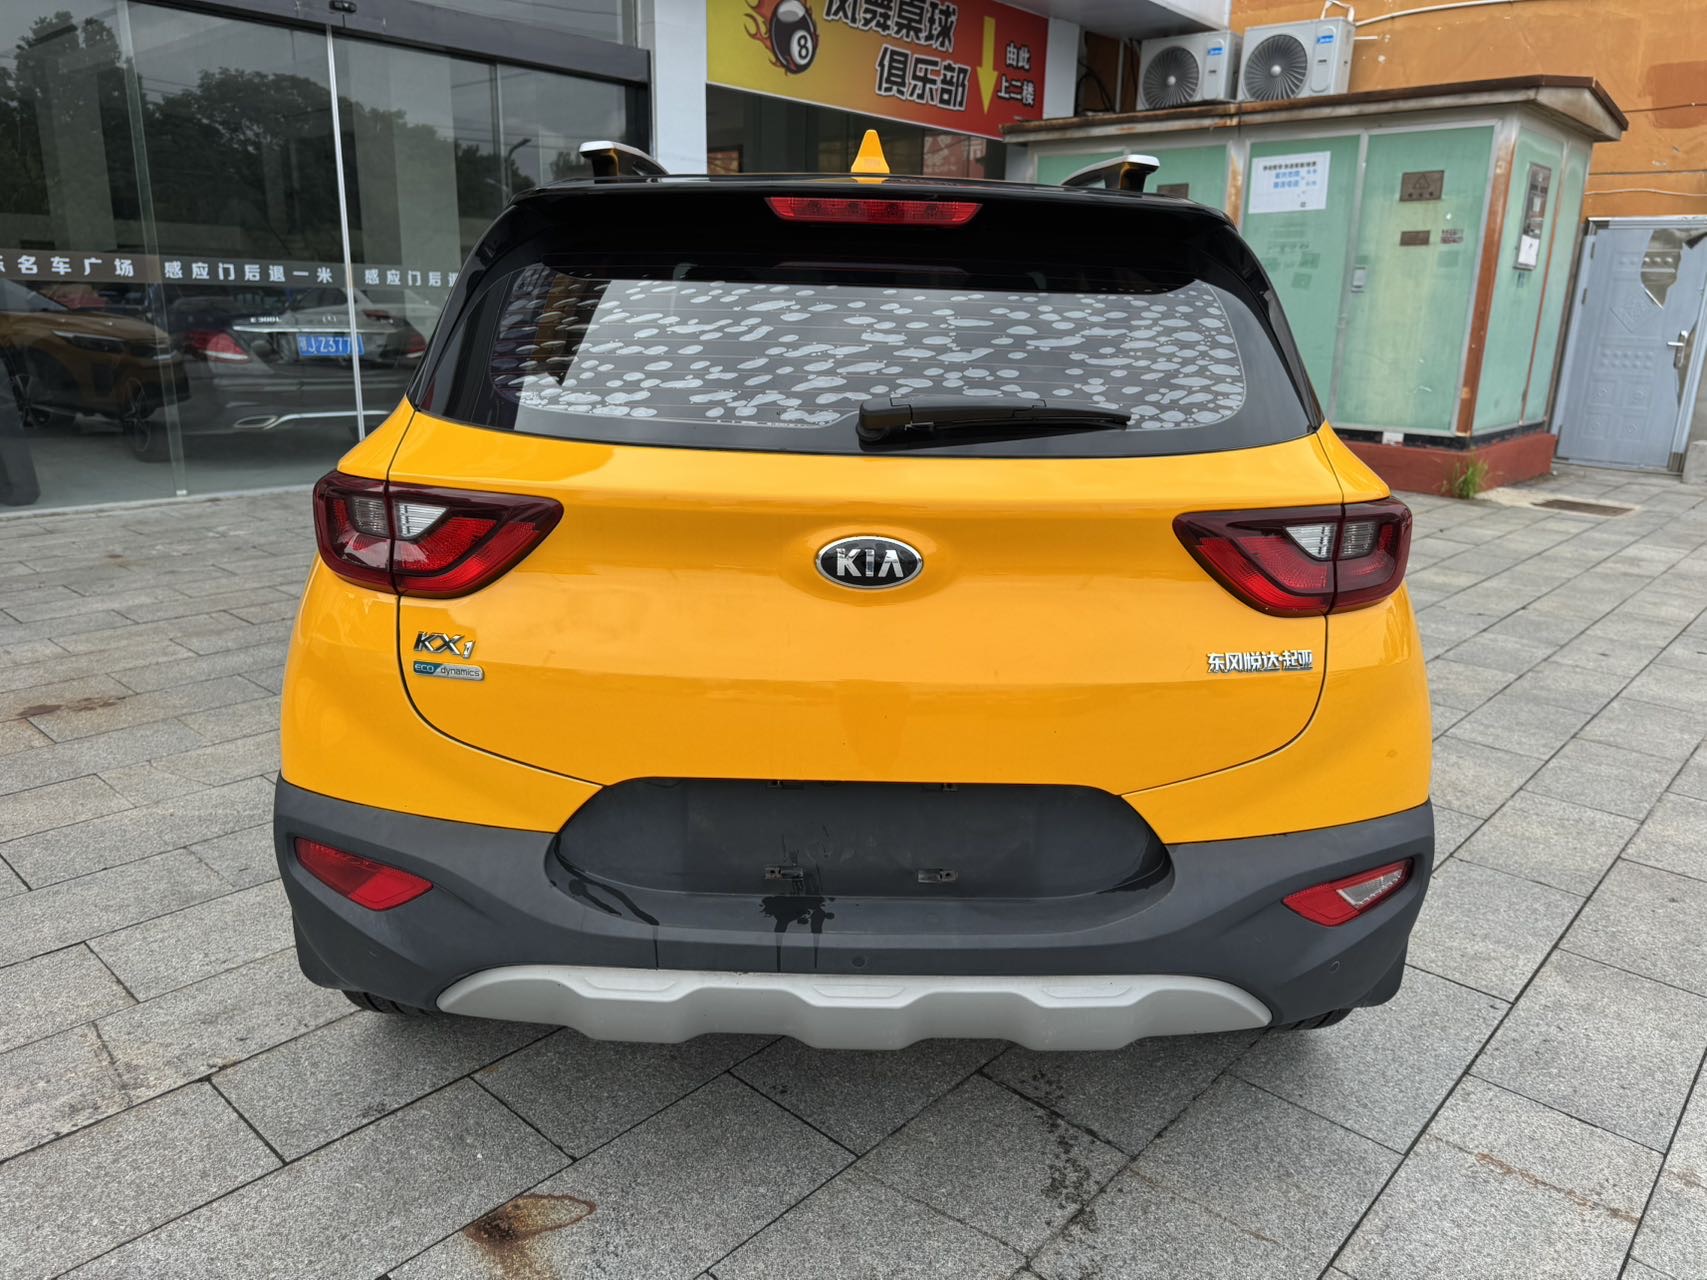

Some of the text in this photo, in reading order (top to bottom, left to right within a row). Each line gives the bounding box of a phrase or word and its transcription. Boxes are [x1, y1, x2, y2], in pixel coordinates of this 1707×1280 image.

[795, 33, 811, 58] 8
[1006, 42, 1031, 70] 由此
[876, 44, 970, 111] 俱乐部
[998, 75, 1034, 106] 上二楼
[164, 261, 333, 284] 感应门后退一米
[835, 547, 904, 578] KIA
[413, 631, 476, 659] KX1
[440, 666, 480, 677] dynamics
